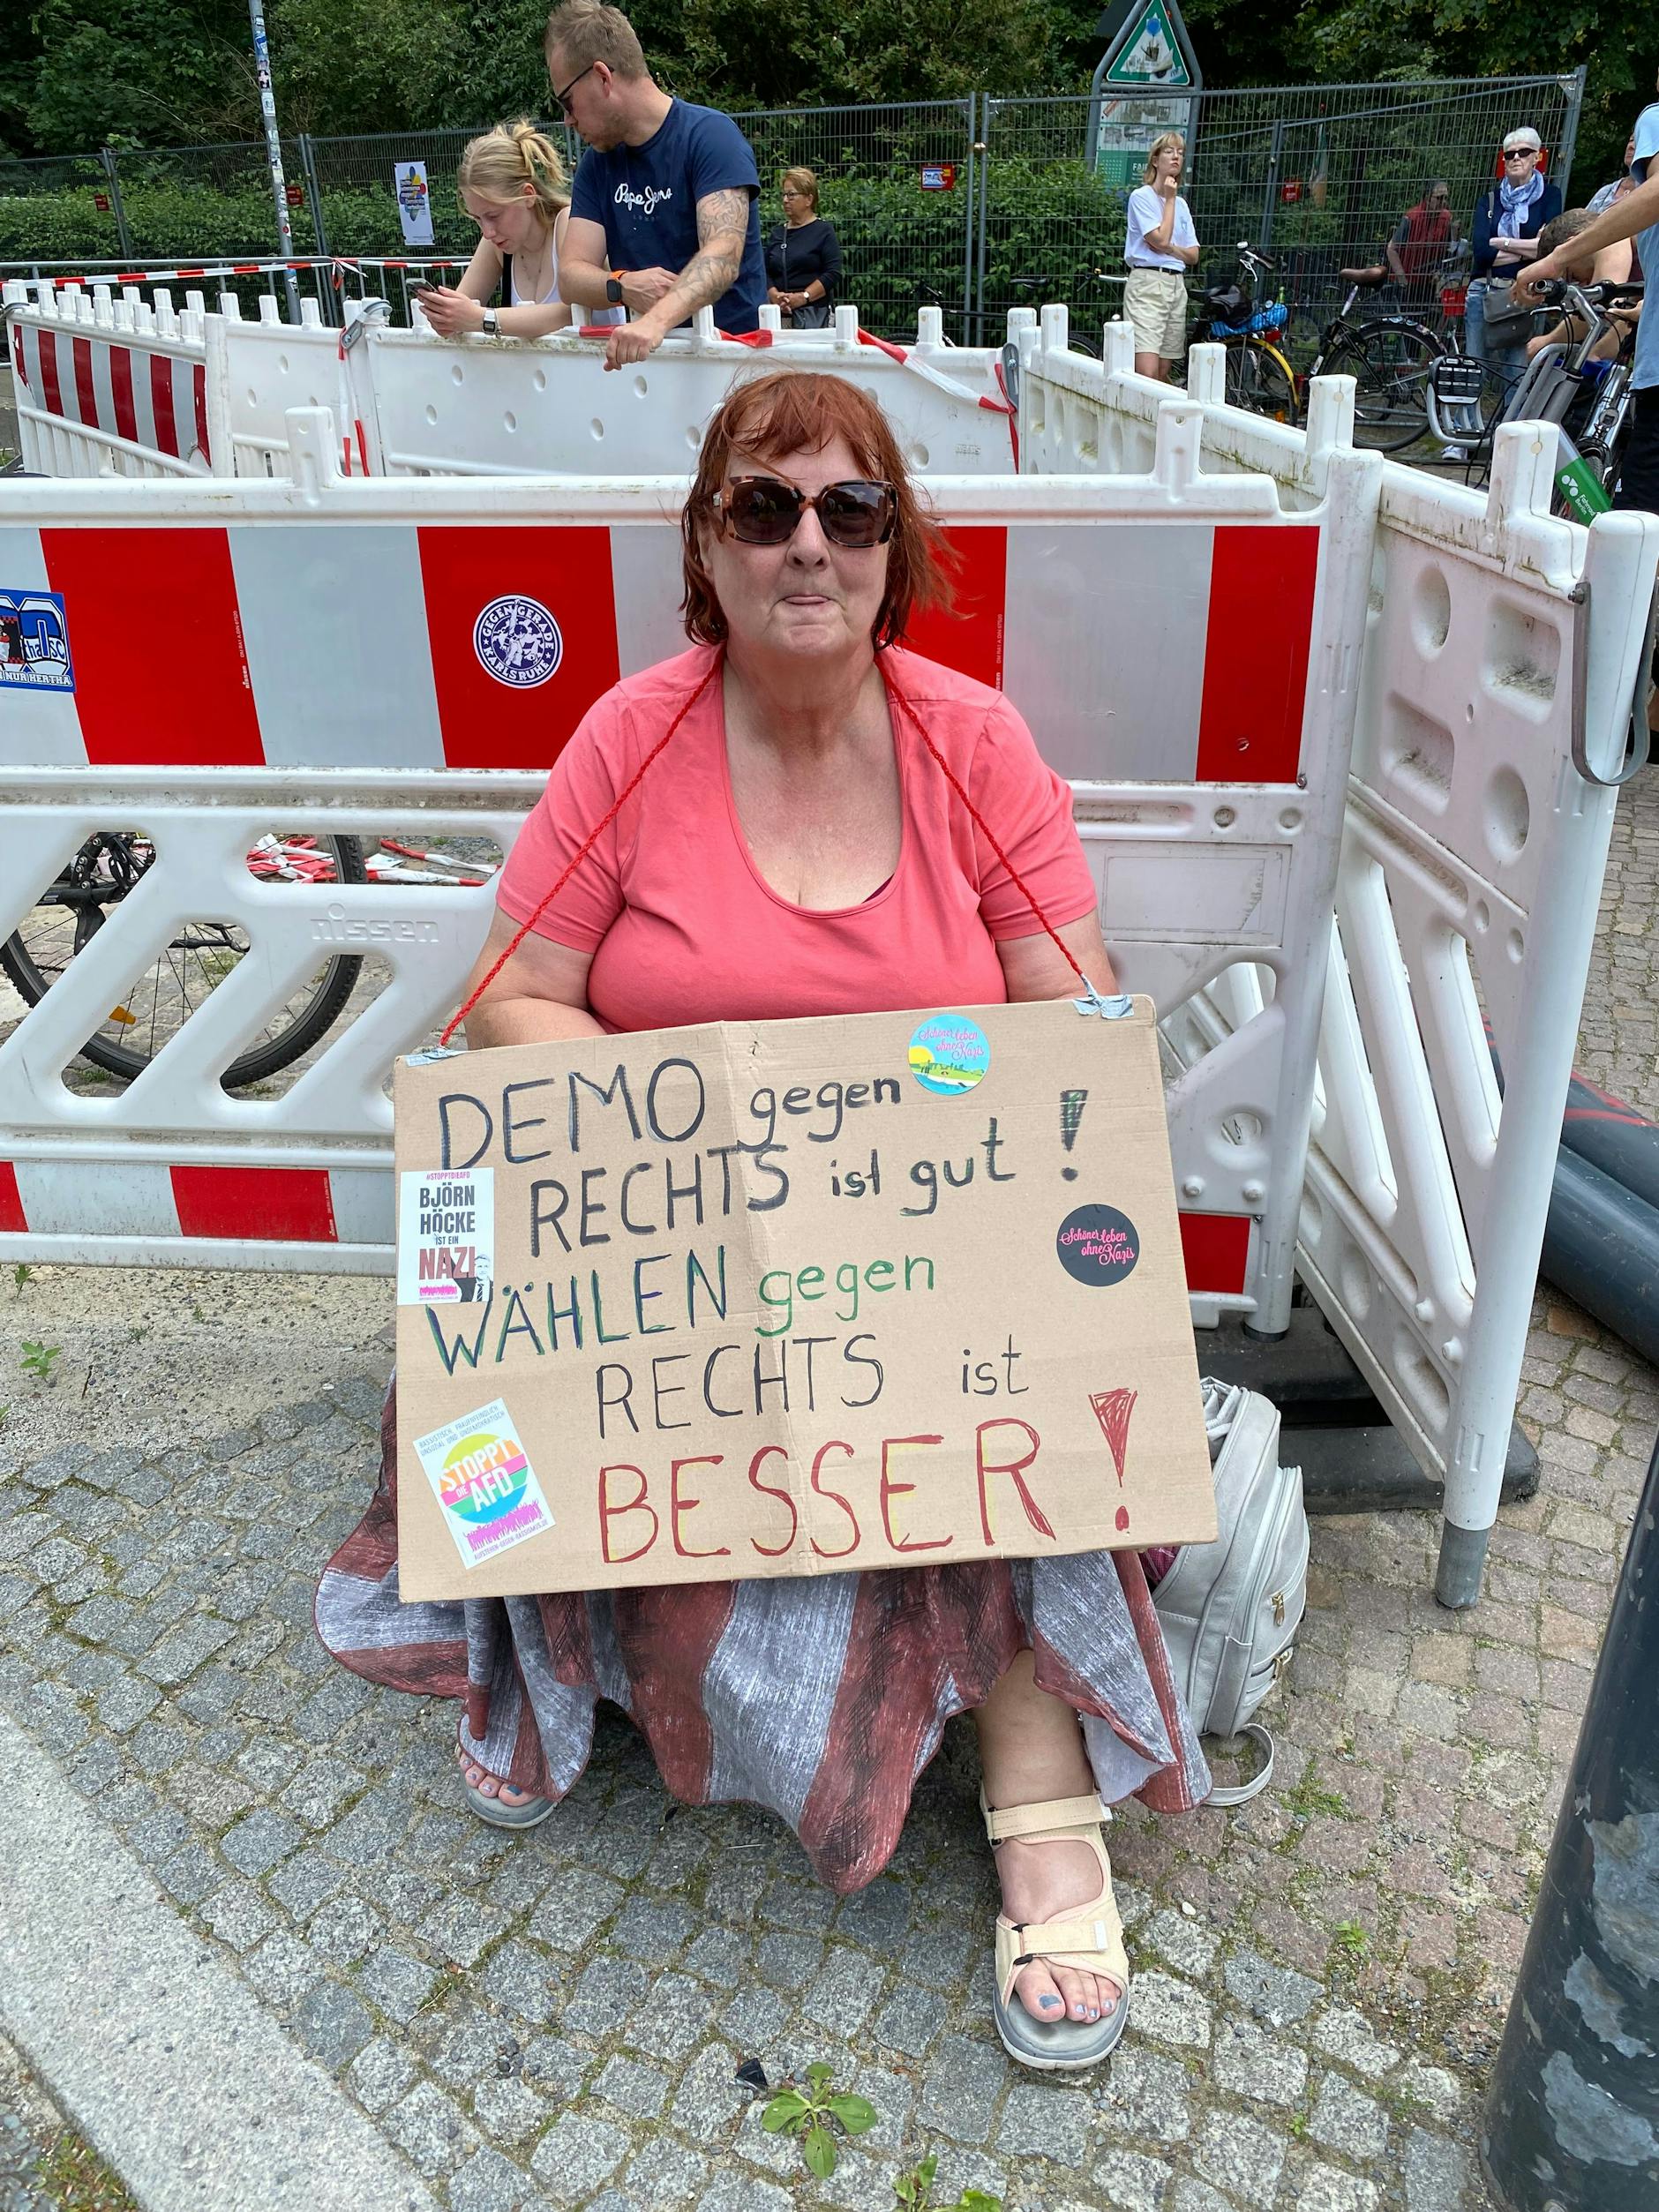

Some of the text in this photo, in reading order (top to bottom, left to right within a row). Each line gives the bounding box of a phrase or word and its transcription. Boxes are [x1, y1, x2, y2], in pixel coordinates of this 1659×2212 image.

[614, 183, 645, 211] Pepe
[5, 671, 27, 682] NUR
[29, 673, 71, 685] HERTHA
[483, 647, 549, 680] KARLSRUHE
[310, 903, 439, 942] nissen
[439, 1058, 902, 1170] DEMO gegen
[530, 1089, 1089, 1257] RECHTS ist gut !
[419, 1181, 475, 1208] BJÖRN
[420, 1209, 476, 1234] HÖCKE
[1059, 1227, 1128, 1245] Schöner leben
[436, 1236, 459, 1245] IST EIN
[1081, 1241, 1136, 1265] ohne Nazis
[419, 1246, 476, 1280] NAZI
[425, 1245, 935, 1376] WÄHLEN gegen
[597, 1333, 1029, 1439] RECHTS ist
[440, 1439, 512, 1492] STOPPT
[599, 1388, 1138, 1563] BESSER !
[455, 1466, 514, 1512] DIE AFD
